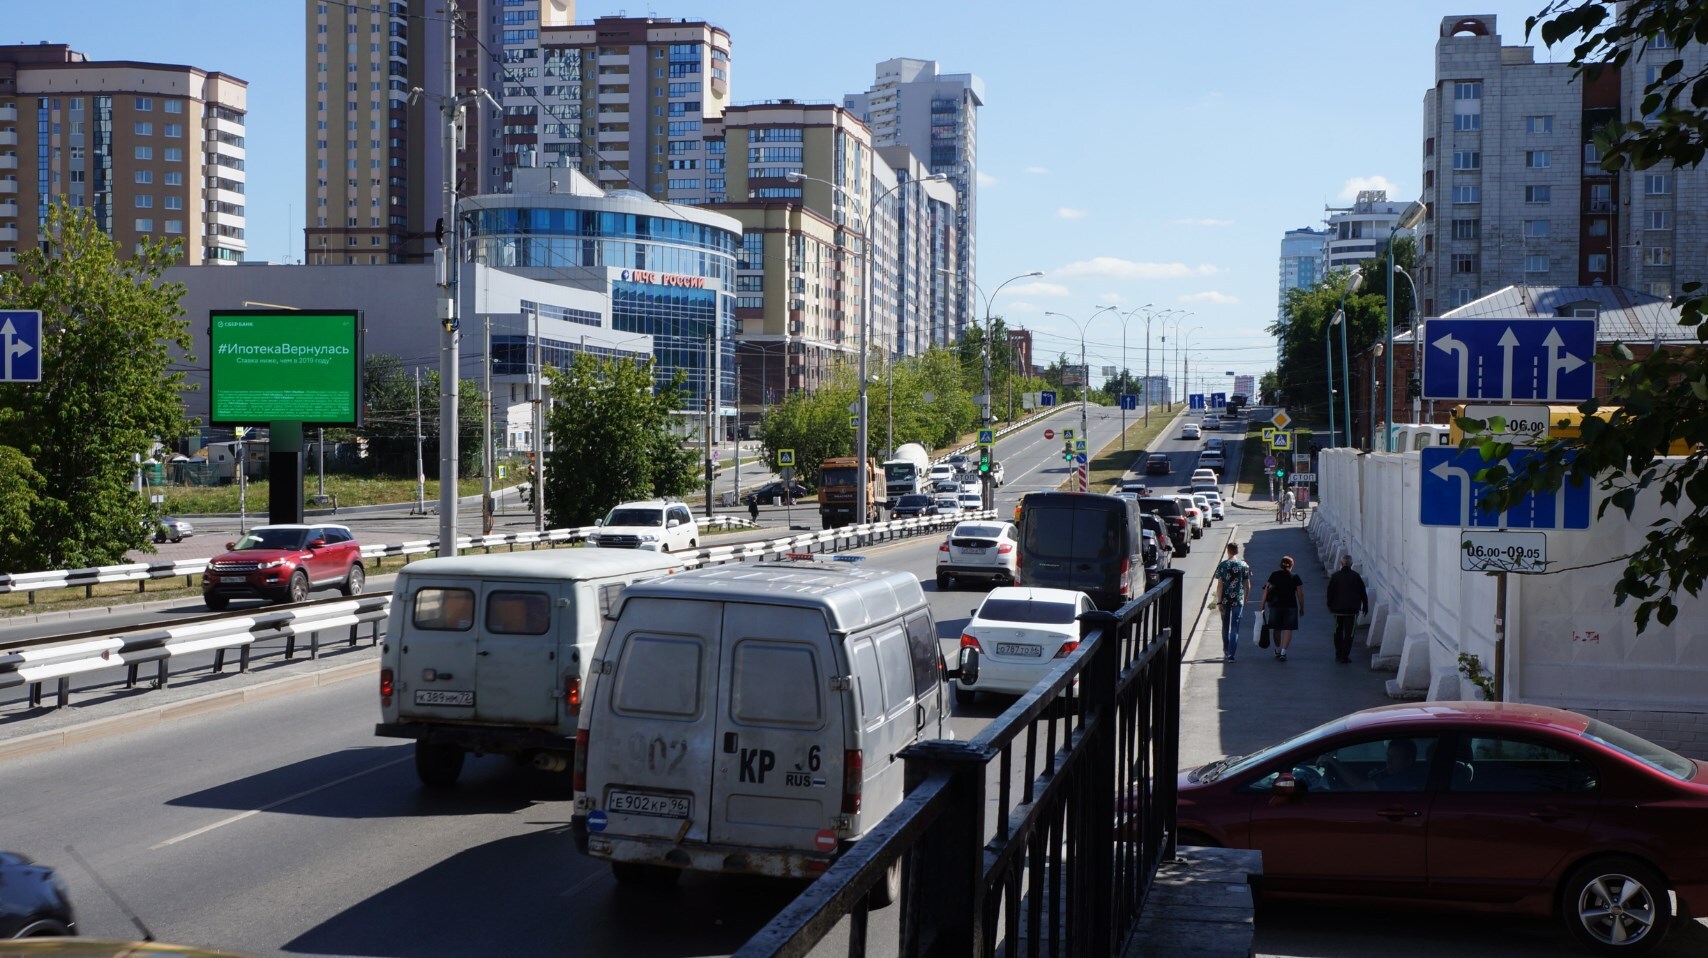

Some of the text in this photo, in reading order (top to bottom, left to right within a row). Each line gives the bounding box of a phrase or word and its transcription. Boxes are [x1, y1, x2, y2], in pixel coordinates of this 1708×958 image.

[633, 270, 705, 289] МЧС РОССИИ
[217, 343, 350, 356] #ИпотекаВернулась
[1466, 545, 1540, 560] 06.00-09.05
[785, 774, 811, 787] RUS
